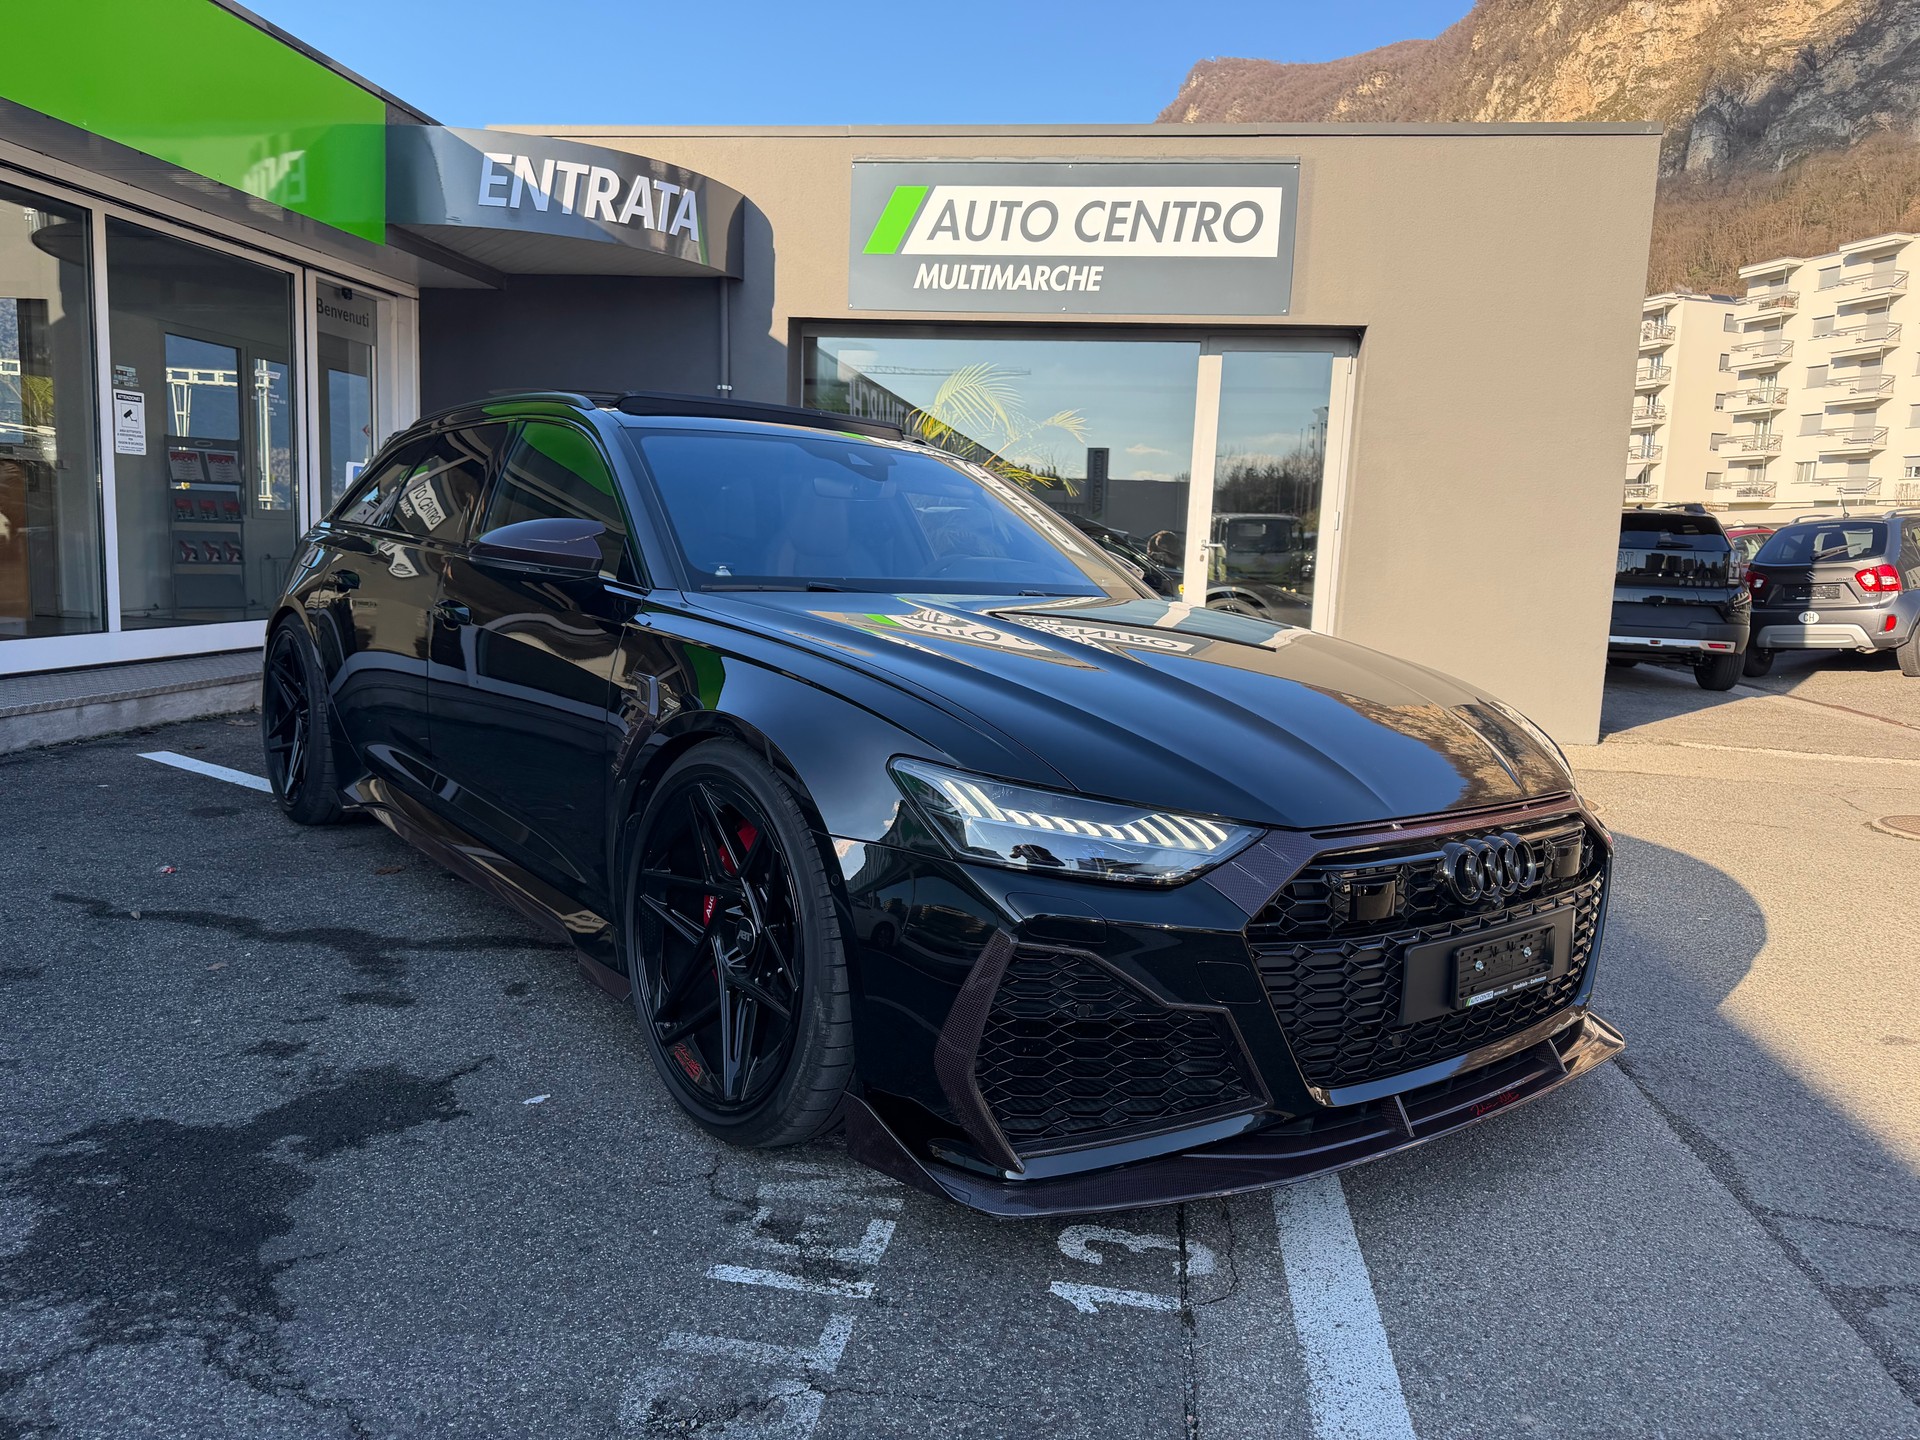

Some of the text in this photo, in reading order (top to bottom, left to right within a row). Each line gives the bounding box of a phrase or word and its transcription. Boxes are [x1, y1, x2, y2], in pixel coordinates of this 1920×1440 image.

[478, 152, 699, 242] ENTRATA
[926, 199, 1264, 244] AUTO CENTRO
[913, 263, 1104, 292] MULTIMARCHE
[316, 297, 370, 328] Benvenuti
[1803, 613, 1815, 622] CH
[1050, 1224, 1215, 1314] 13
